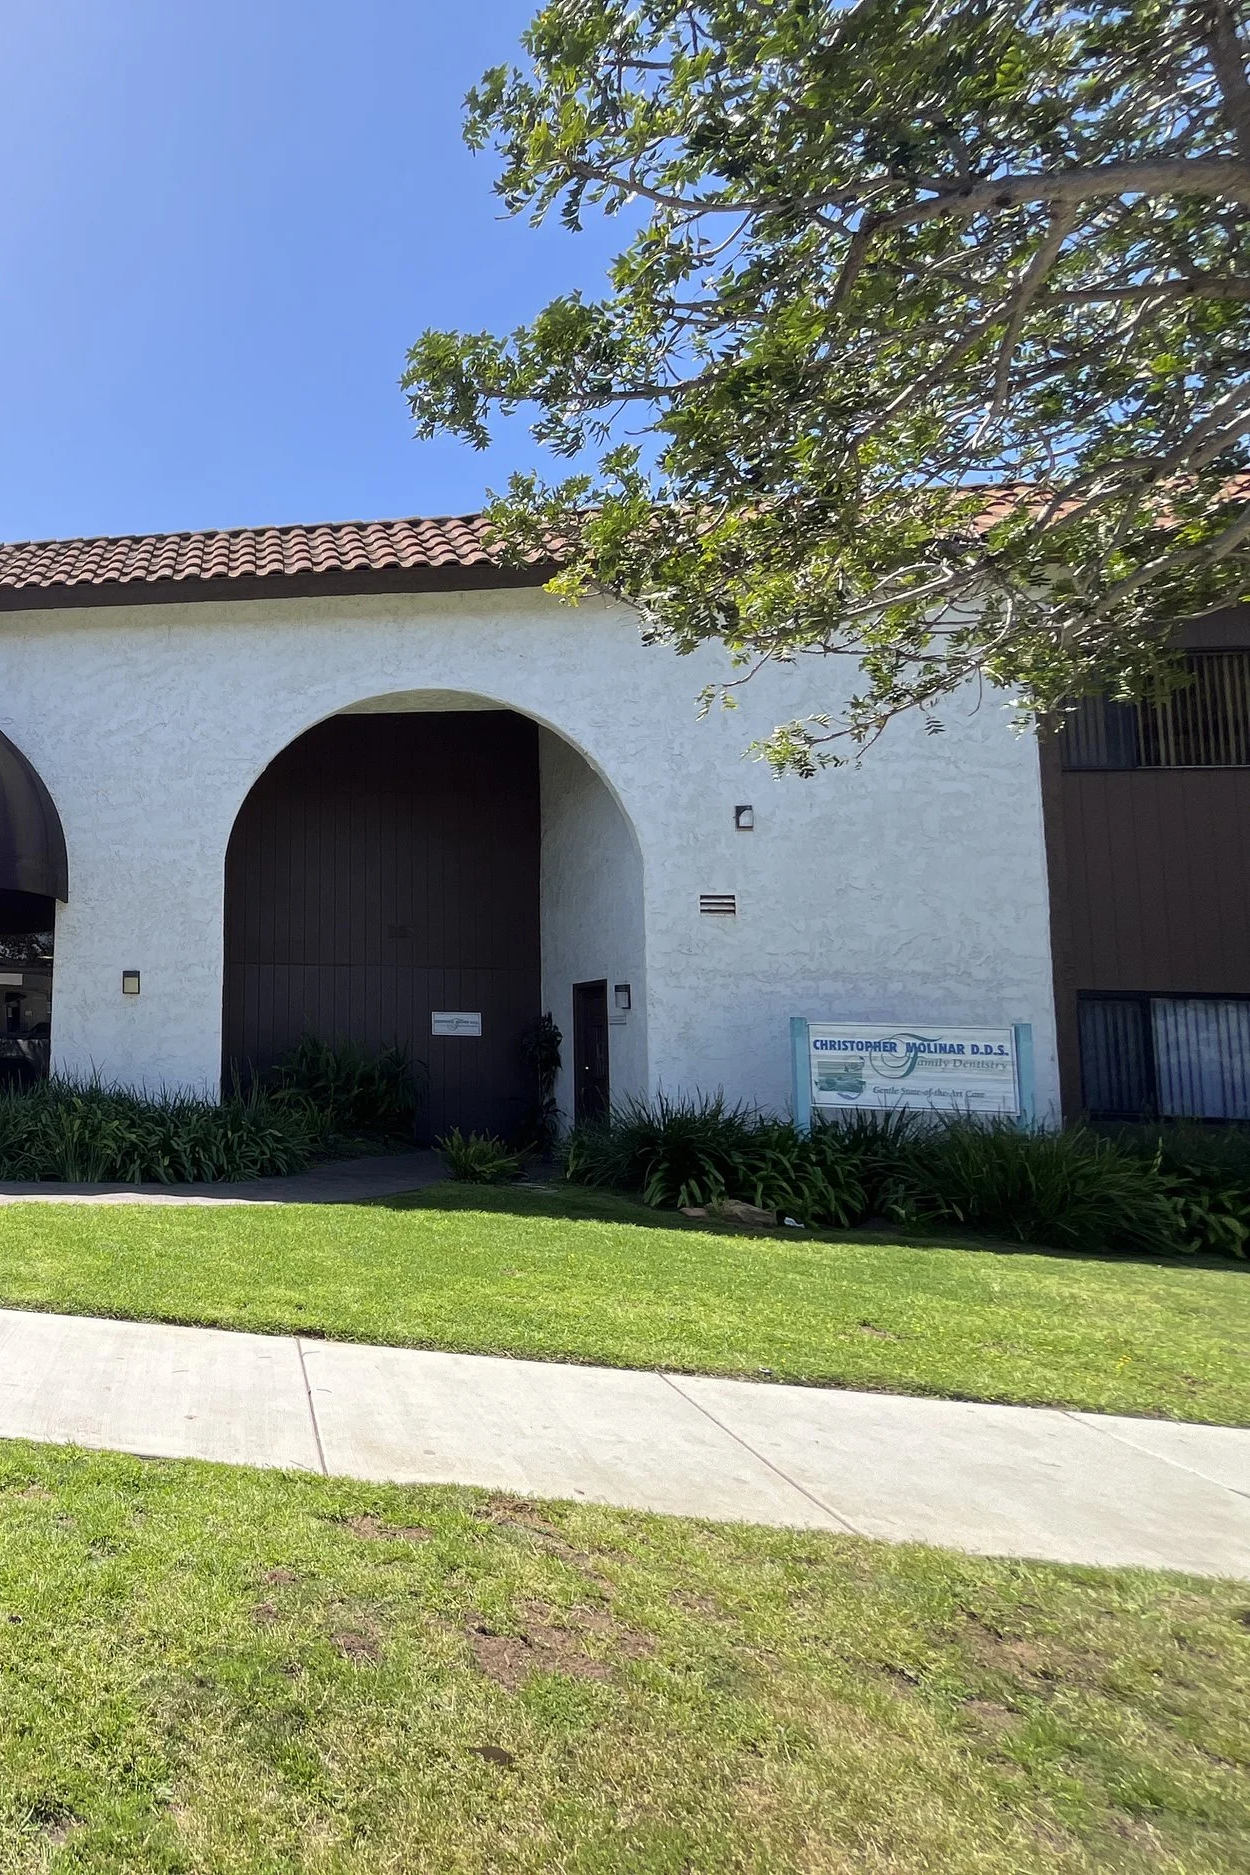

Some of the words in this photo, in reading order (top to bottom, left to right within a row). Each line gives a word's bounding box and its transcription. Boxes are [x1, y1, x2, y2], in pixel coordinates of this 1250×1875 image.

[813, 1039, 897, 1052] CHRISTOPHER
[906, 1042, 965, 1054] MOLINAR
[971, 1044, 1009, 1056] D.D.S.
[953, 1058, 1008, 1071] Dentistry
[872, 1086, 899, 1095] Gentle
